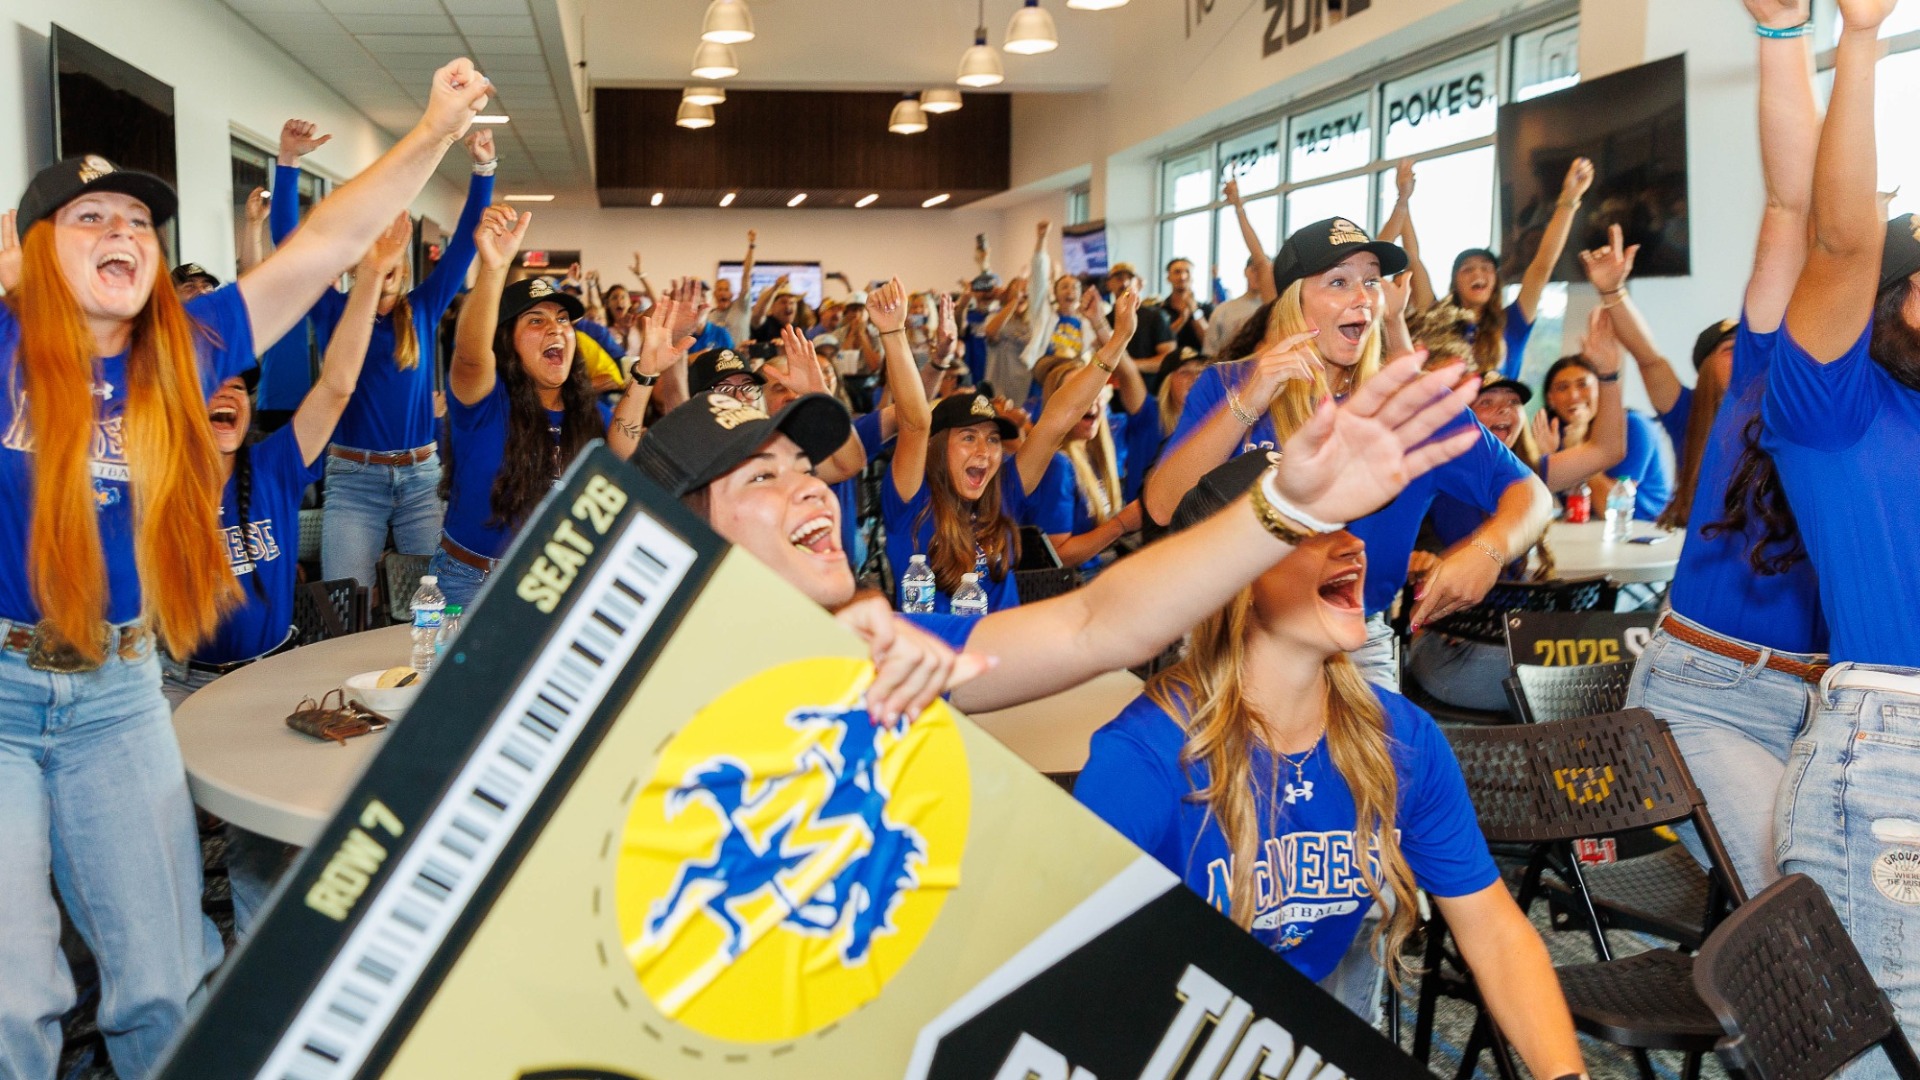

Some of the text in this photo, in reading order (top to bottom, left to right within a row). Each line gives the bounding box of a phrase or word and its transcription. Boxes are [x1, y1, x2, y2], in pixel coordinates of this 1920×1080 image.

[516, 474, 628, 614] SEAT 26
[1534, 639, 1620, 667] 2026
[304, 800, 405, 922] ROW 7
